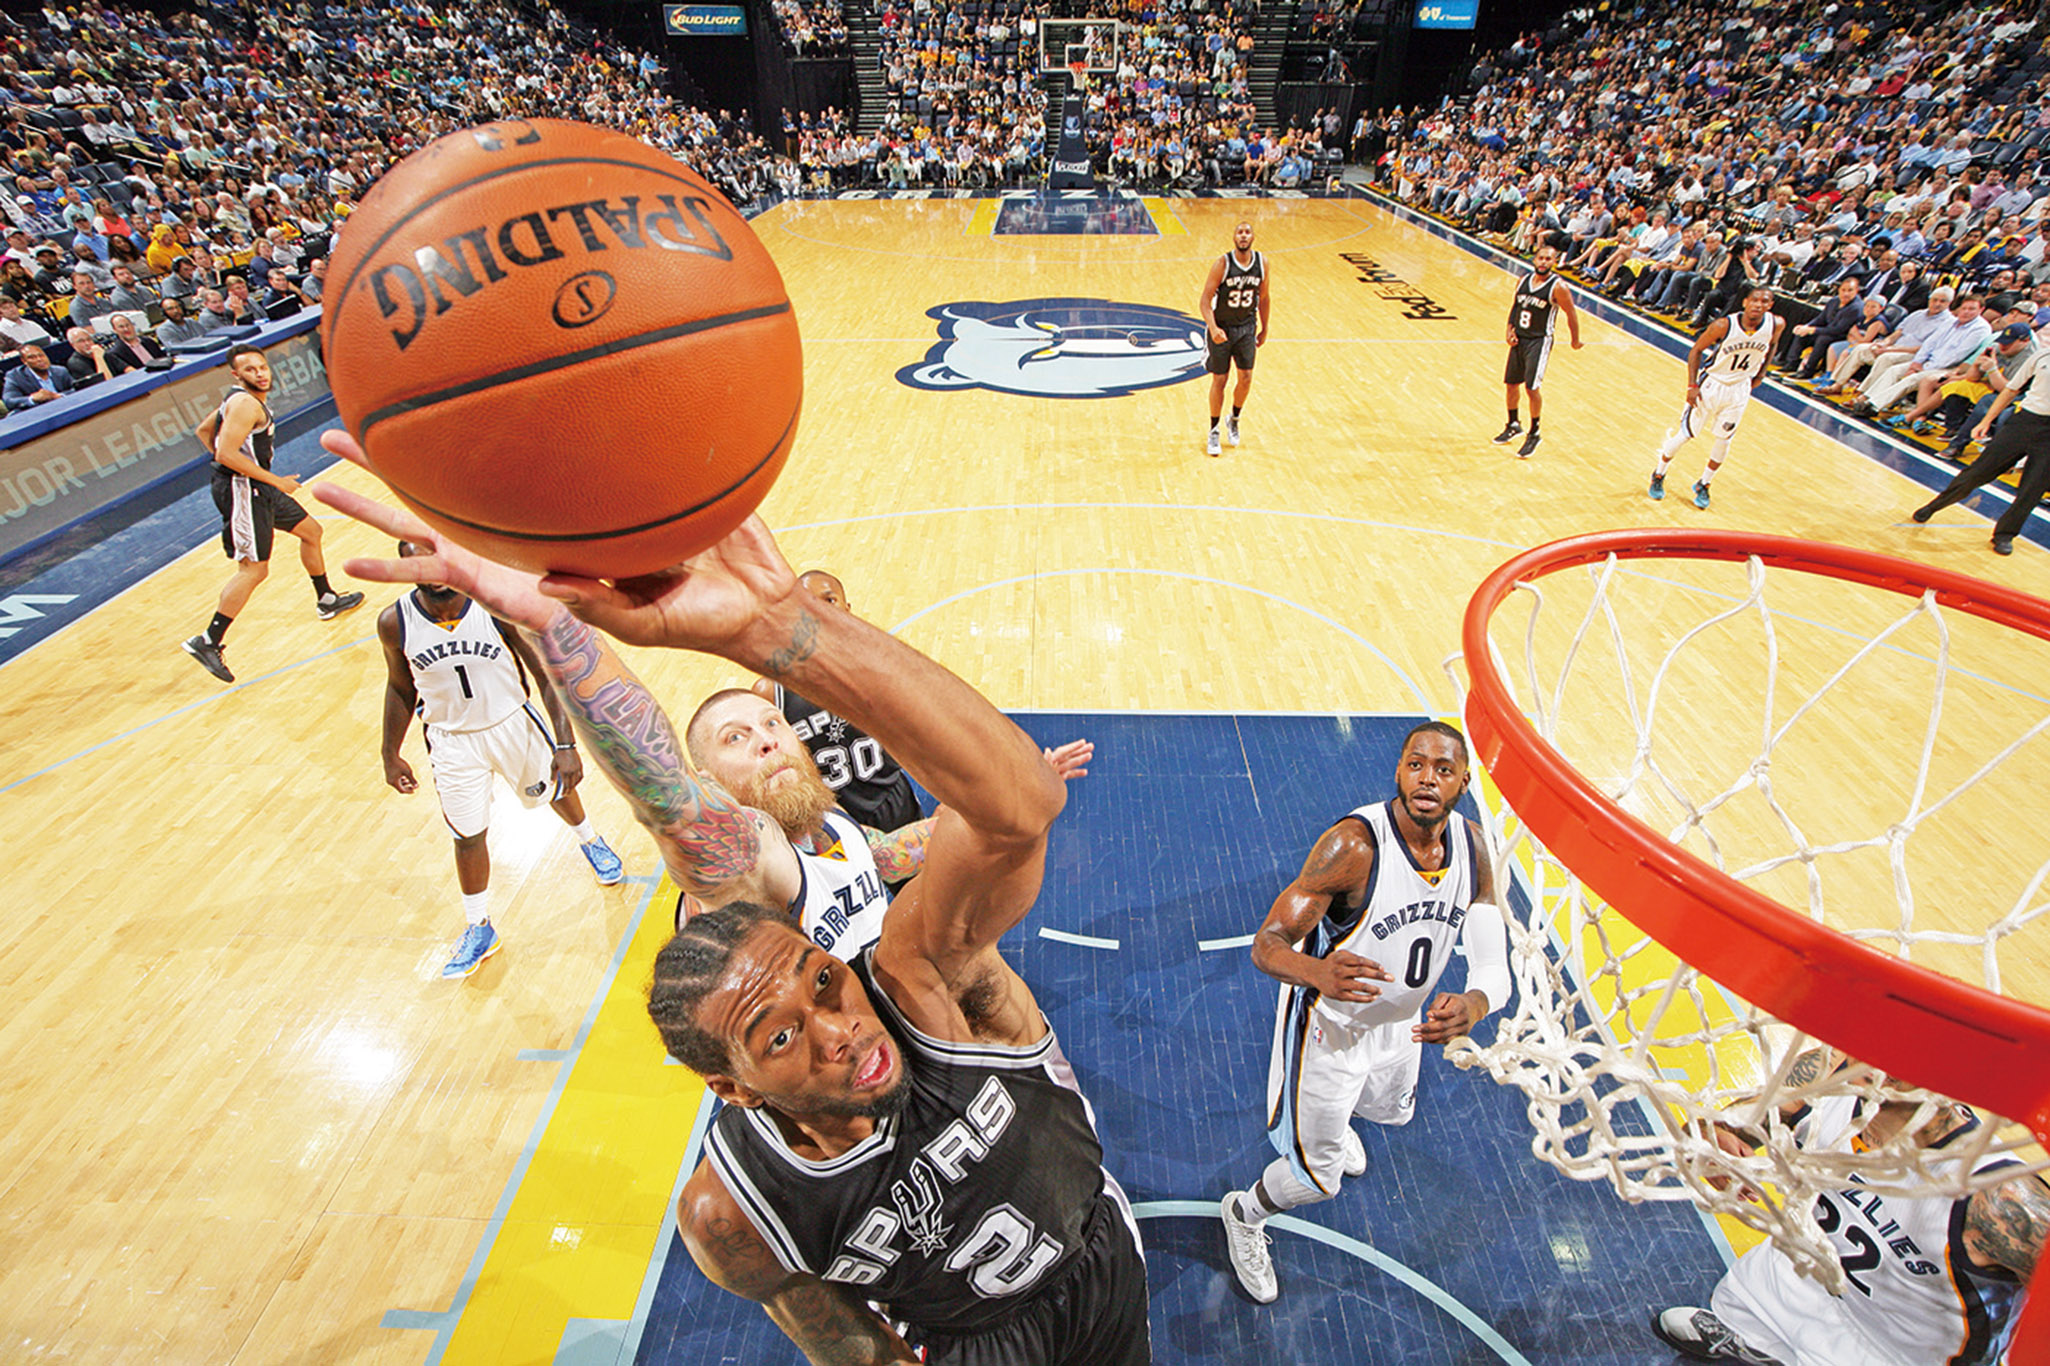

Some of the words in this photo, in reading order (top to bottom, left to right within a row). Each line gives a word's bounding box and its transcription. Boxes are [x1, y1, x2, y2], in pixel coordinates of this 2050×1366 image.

[369, 194, 734, 352] SPALDING
[1227, 289, 1255, 309] 33
[1519, 310, 1532, 330] 8
[1730, 353, 1751, 371] 14
[0, 455, 87, 526] JOR
[411, 640, 502, 671] GRIZZLIES
[454, 664, 474, 700] 1
[813, 736, 885, 790] 30
[1404, 936, 1433, 989] 0
[821, 1074, 1017, 1286] SPURS
[943, 1202, 1065, 1299] 2
